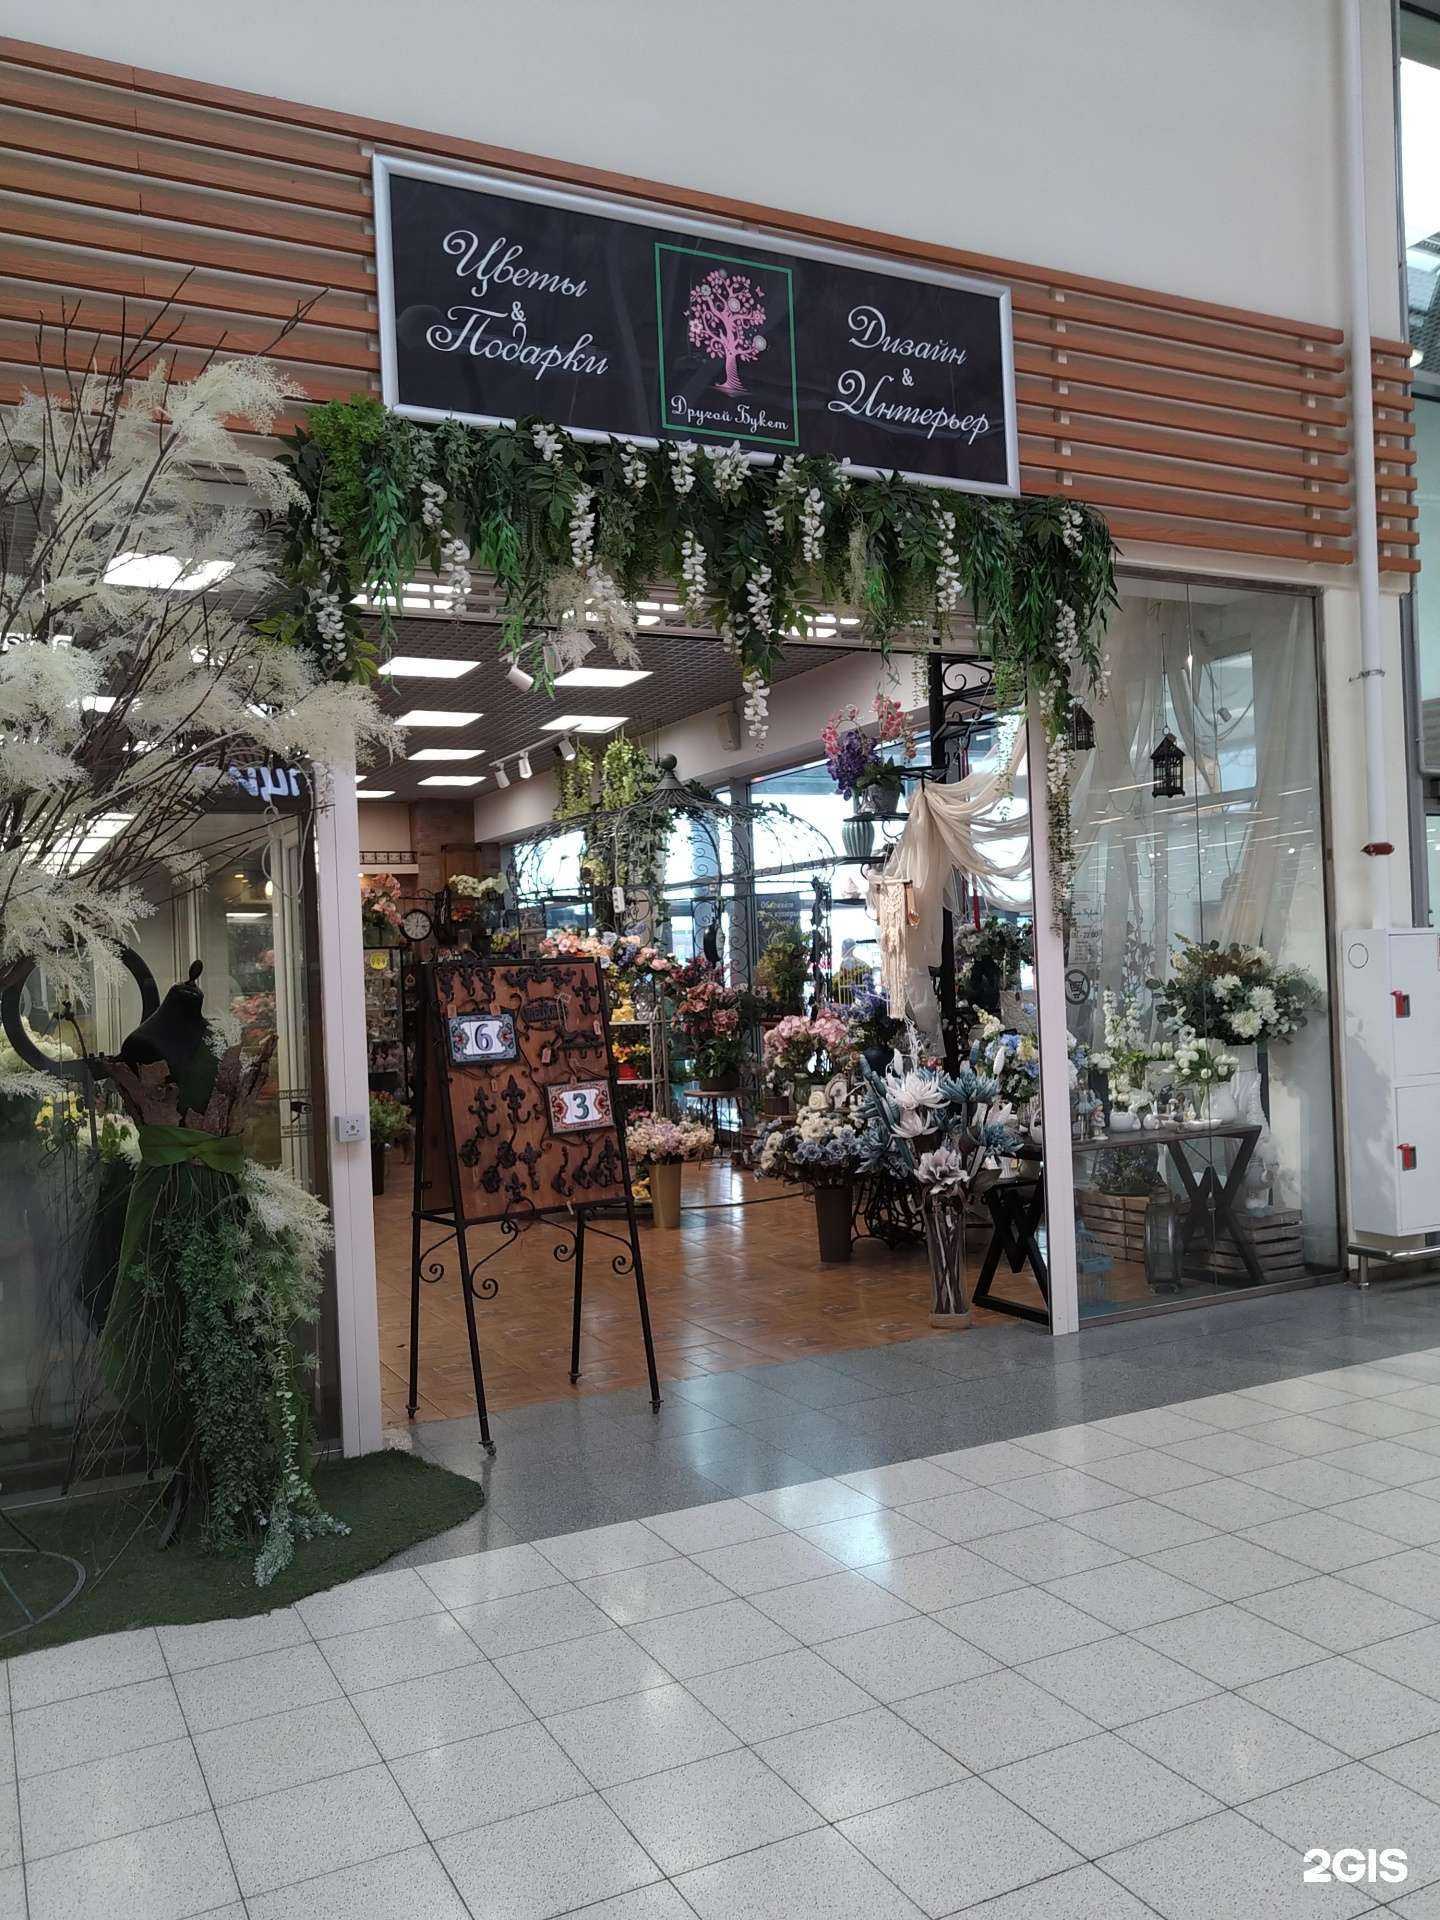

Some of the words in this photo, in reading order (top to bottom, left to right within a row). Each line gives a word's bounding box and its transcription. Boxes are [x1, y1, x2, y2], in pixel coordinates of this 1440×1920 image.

[443, 229, 588, 297] Цветы
[511, 300, 526, 322] &
[426, 305, 609, 381] Подарки
[848, 305, 968, 365] Дизайн
[901, 367, 915, 387] &
[670, 394, 731, 426] Другой
[734, 404, 790, 433] Букет
[828, 369, 989, 446] Интерьер
[474, 1023, 494, 1051] 6
[572, 1092, 590, 1120] 3
